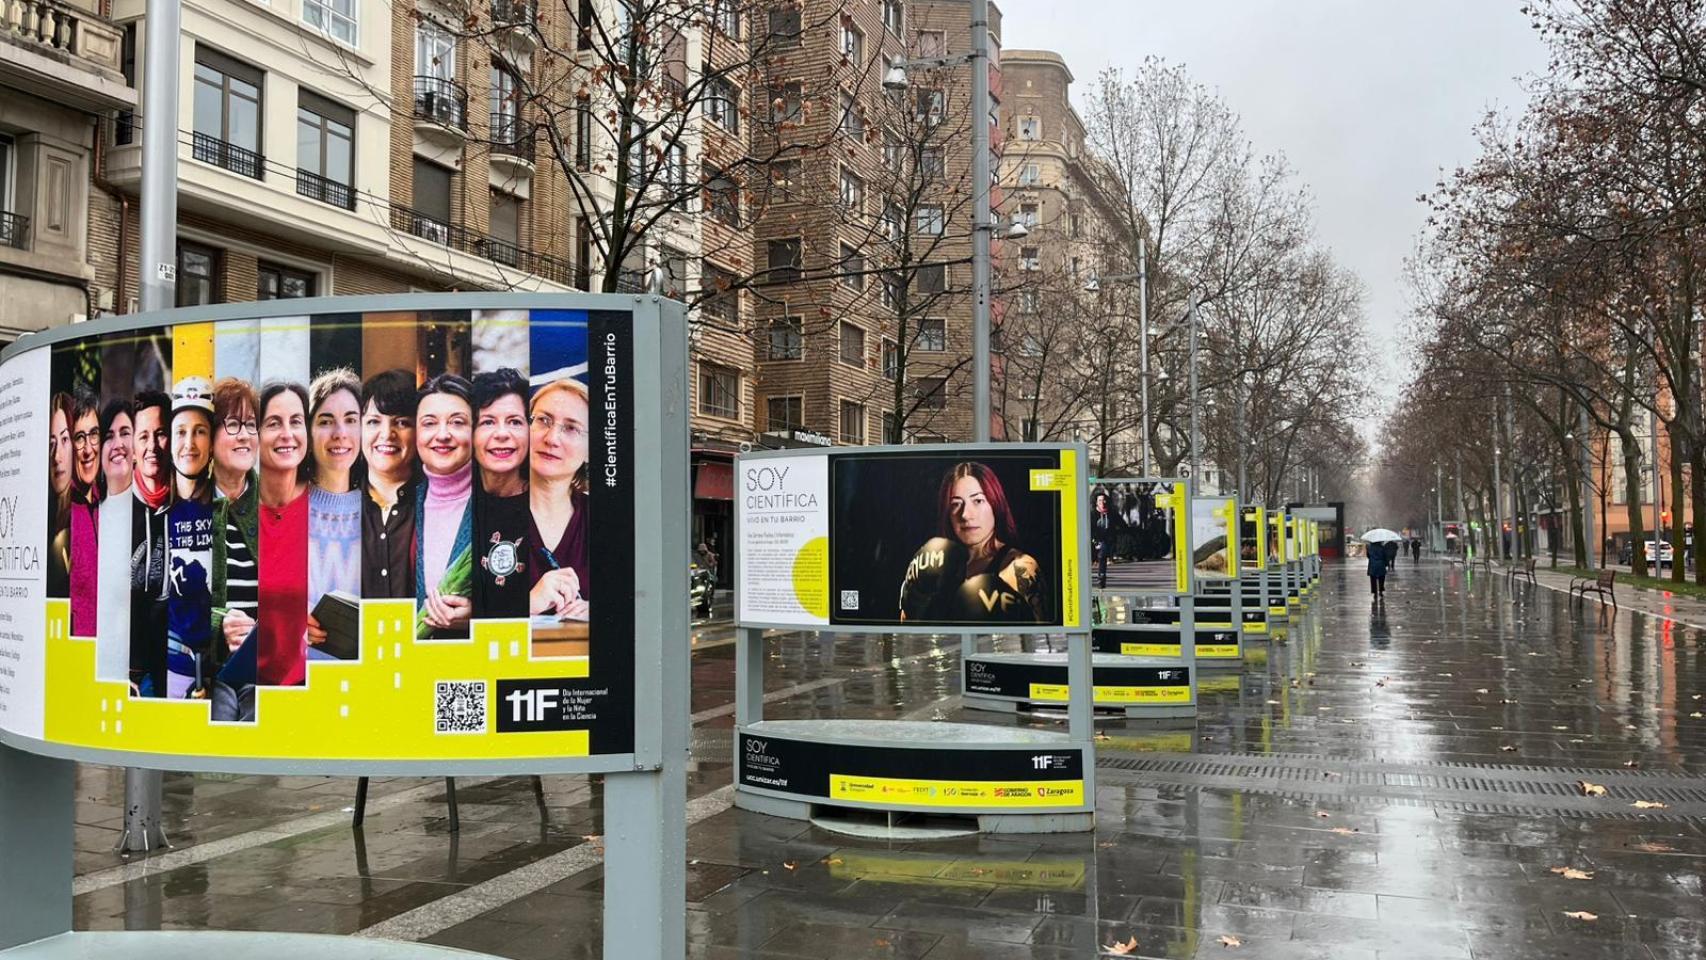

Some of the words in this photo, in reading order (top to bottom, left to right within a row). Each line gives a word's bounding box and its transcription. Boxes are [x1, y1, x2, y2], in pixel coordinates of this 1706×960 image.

[604, 333, 617, 487] #CientíficaEnTuBarrio
[746, 466, 789, 492] SOY
[746, 492, 818, 509] CIENTÍFICA
[195, 519, 212, 532] SKY
[572, 688, 608, 697] Internacional
[505, 689, 560, 721] 11F
[577, 697, 593, 706] Mujer
[577, 712, 597, 720] Ciencia
[746, 739, 768, 754] SOY
[1031, 755, 1053, 770] 11F
[1046, 788, 1074, 796] Zaragoza
